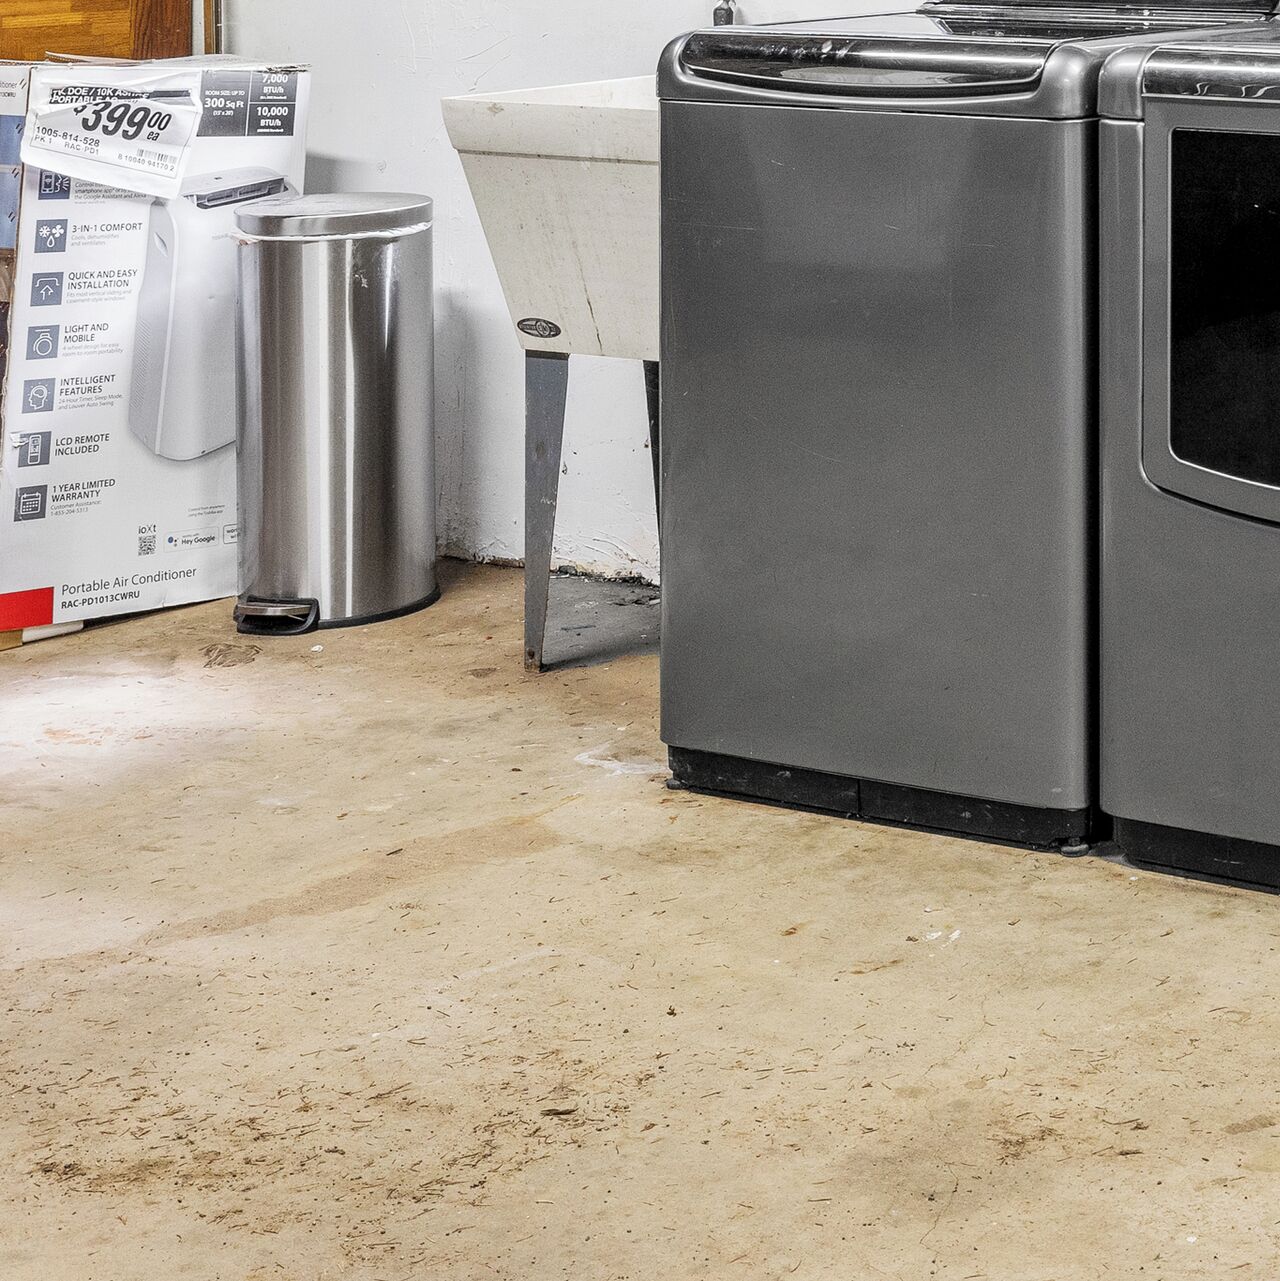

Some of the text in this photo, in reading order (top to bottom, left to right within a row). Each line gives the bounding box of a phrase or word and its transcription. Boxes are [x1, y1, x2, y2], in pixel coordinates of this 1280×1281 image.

[262, 74, 288, 84] 7,000
[204, 98, 225, 108] 300
[226, 101, 235, 109] Sq
[256, 107, 288, 117] 10,000
[34, 134, 45, 144] PK
[36, 126, 100, 147] 1005-814-528
[146, 132, 160, 141] ea
[72, 223, 143, 233] 3-IN-1 COMFORT
[68, 271, 95, 280] QUICK
[117, 269, 137, 277] EASY
[68, 280, 129, 290] INSTALLATION
[64, 324, 89, 333] LIGHT
[64, 334, 95, 343] MOBILE
[61, 374, 115, 386] INTELLIGENT
[60, 385, 103, 396] FEATURES
[56, 433, 110, 446] LCD REMOTE
[55, 445, 100, 456] INCLUDED
[58, 483, 80, 492] YEAR
[82, 479, 116, 490] LIMITED
[51, 490, 101, 502] WARRANTY
[194, 535, 216, 544] Google
[62, 568, 196, 595] Portable Air Conditioner
[61, 590, 140, 609] RAC-PD1013CWRU
